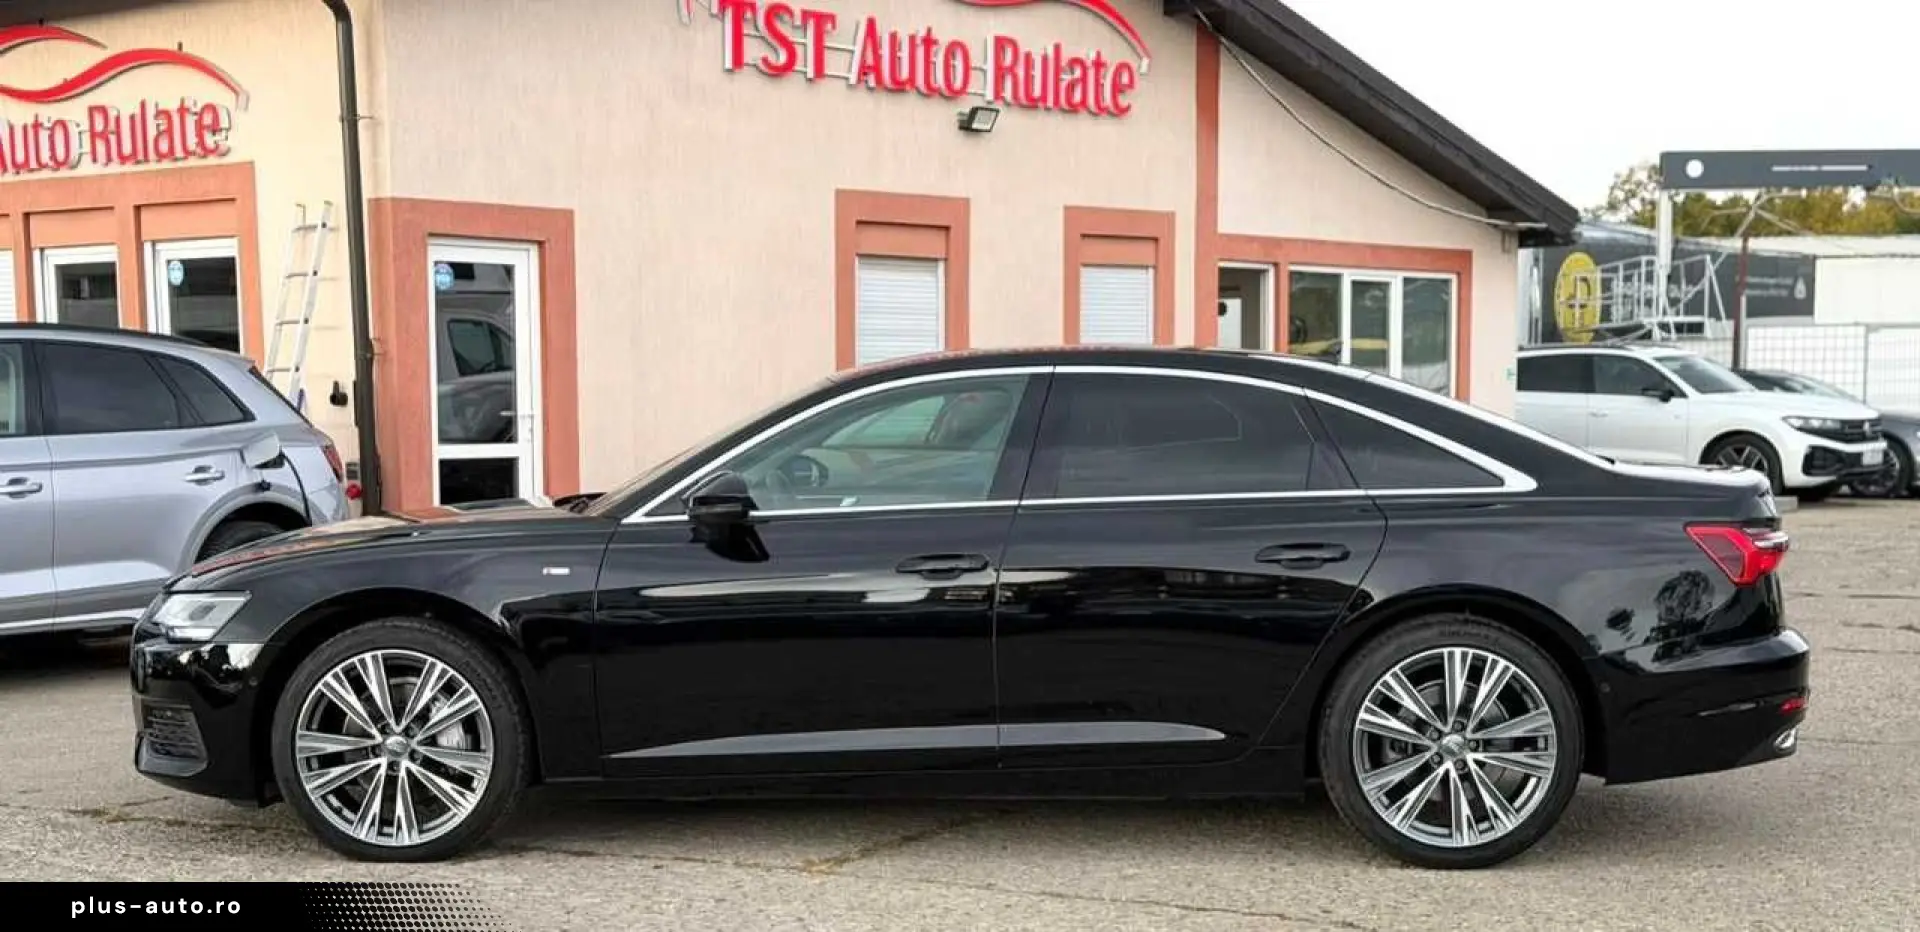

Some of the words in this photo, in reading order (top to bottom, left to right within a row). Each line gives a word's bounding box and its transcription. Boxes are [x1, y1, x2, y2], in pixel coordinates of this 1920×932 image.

[719, 0, 837, 79] TST
[854, 15, 971, 97] Auto
[989, 35, 1136, 117] Rulate
[87, 98, 221, 166] Rulate
